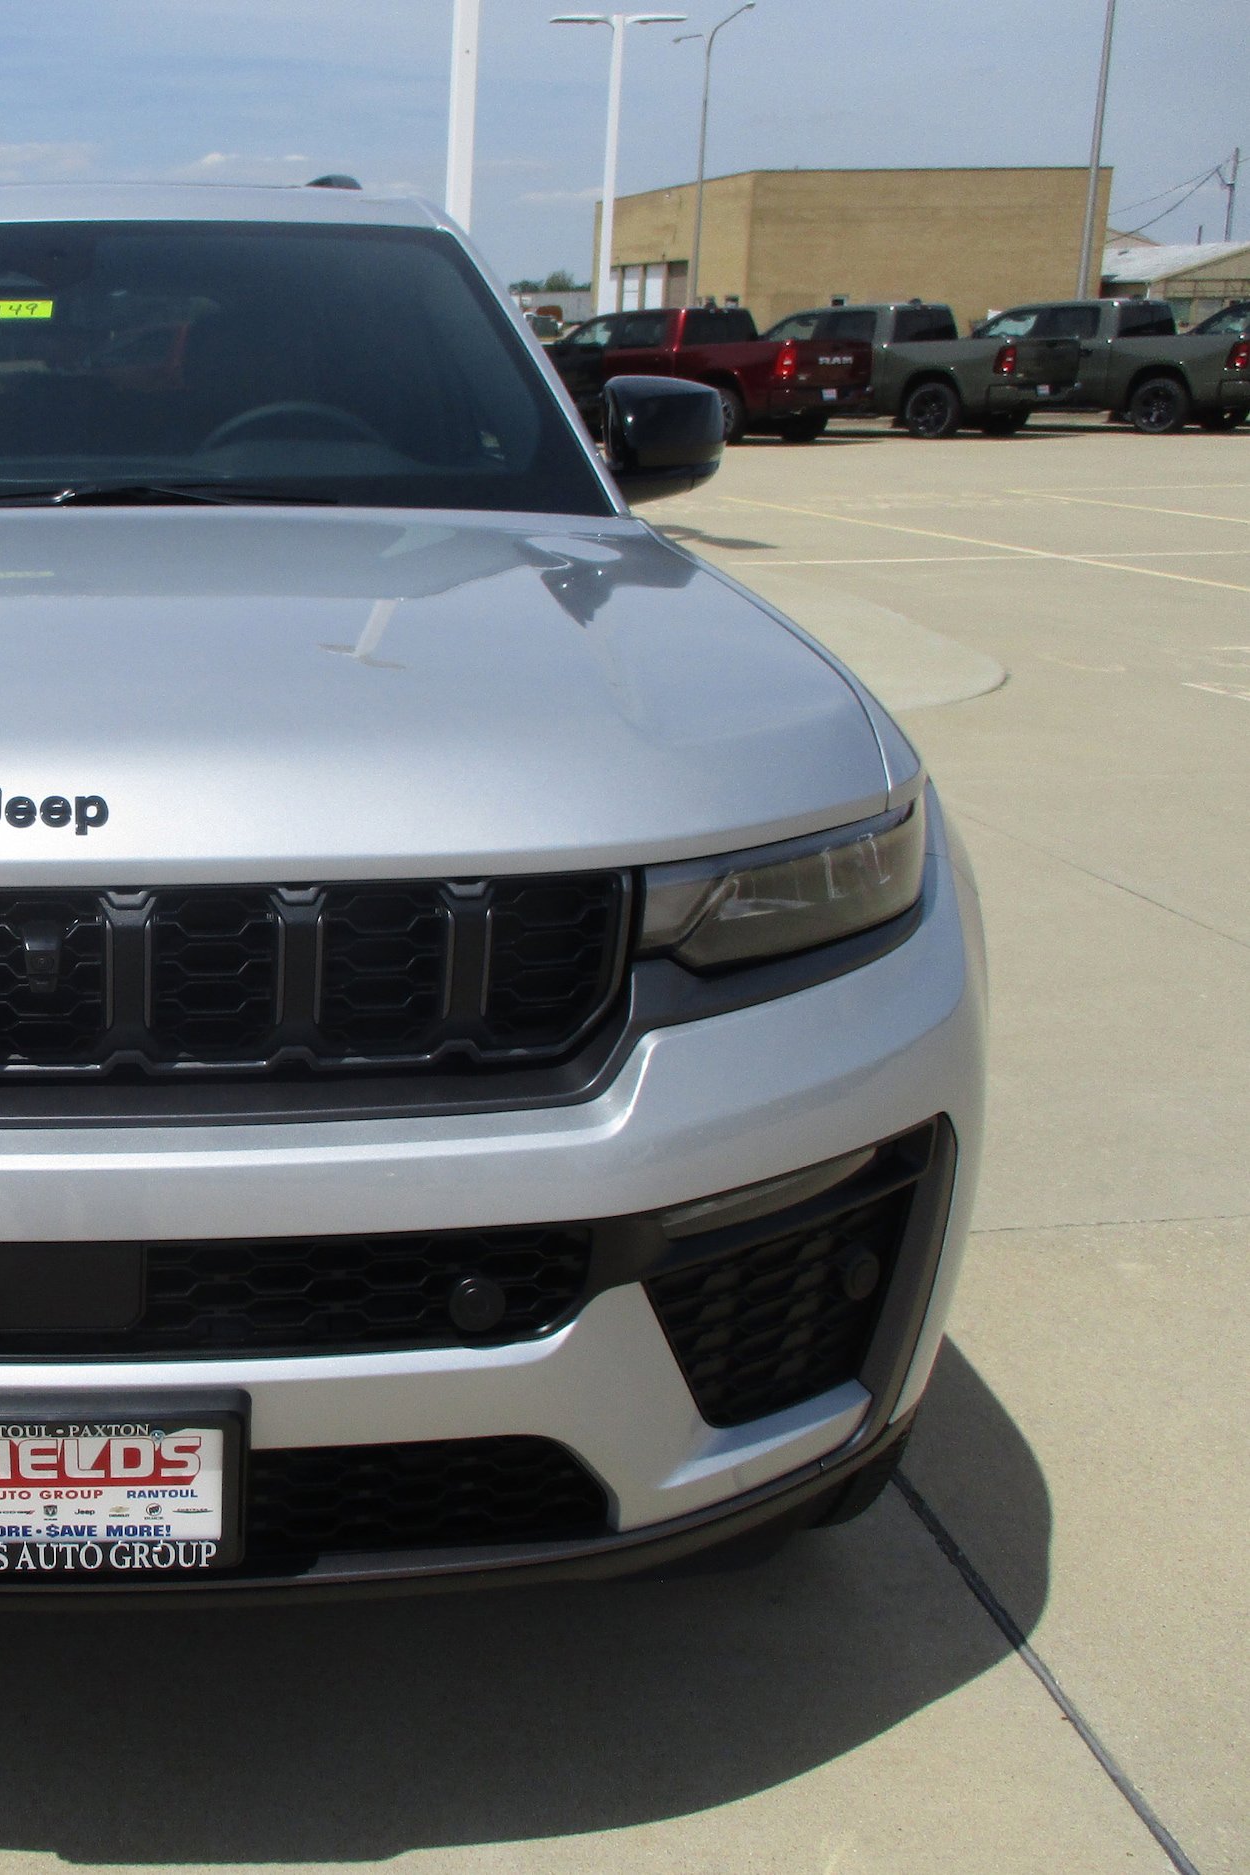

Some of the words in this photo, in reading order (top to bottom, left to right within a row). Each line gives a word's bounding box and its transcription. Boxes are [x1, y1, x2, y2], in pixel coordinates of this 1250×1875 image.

[818, 355, 853, 365] RAM
[68, 1423, 150, 1438] PAXTON
[39, 1489, 104, 1500] GROUP
[126, 1488, 199, 1499] RANTOUL
[74, 1508, 96, 1516] Jeep
[105, 1524, 172, 1537] MORE!
[14, 1541, 104, 1571] AUTO
[108, 1540, 218, 1570] GROUP
